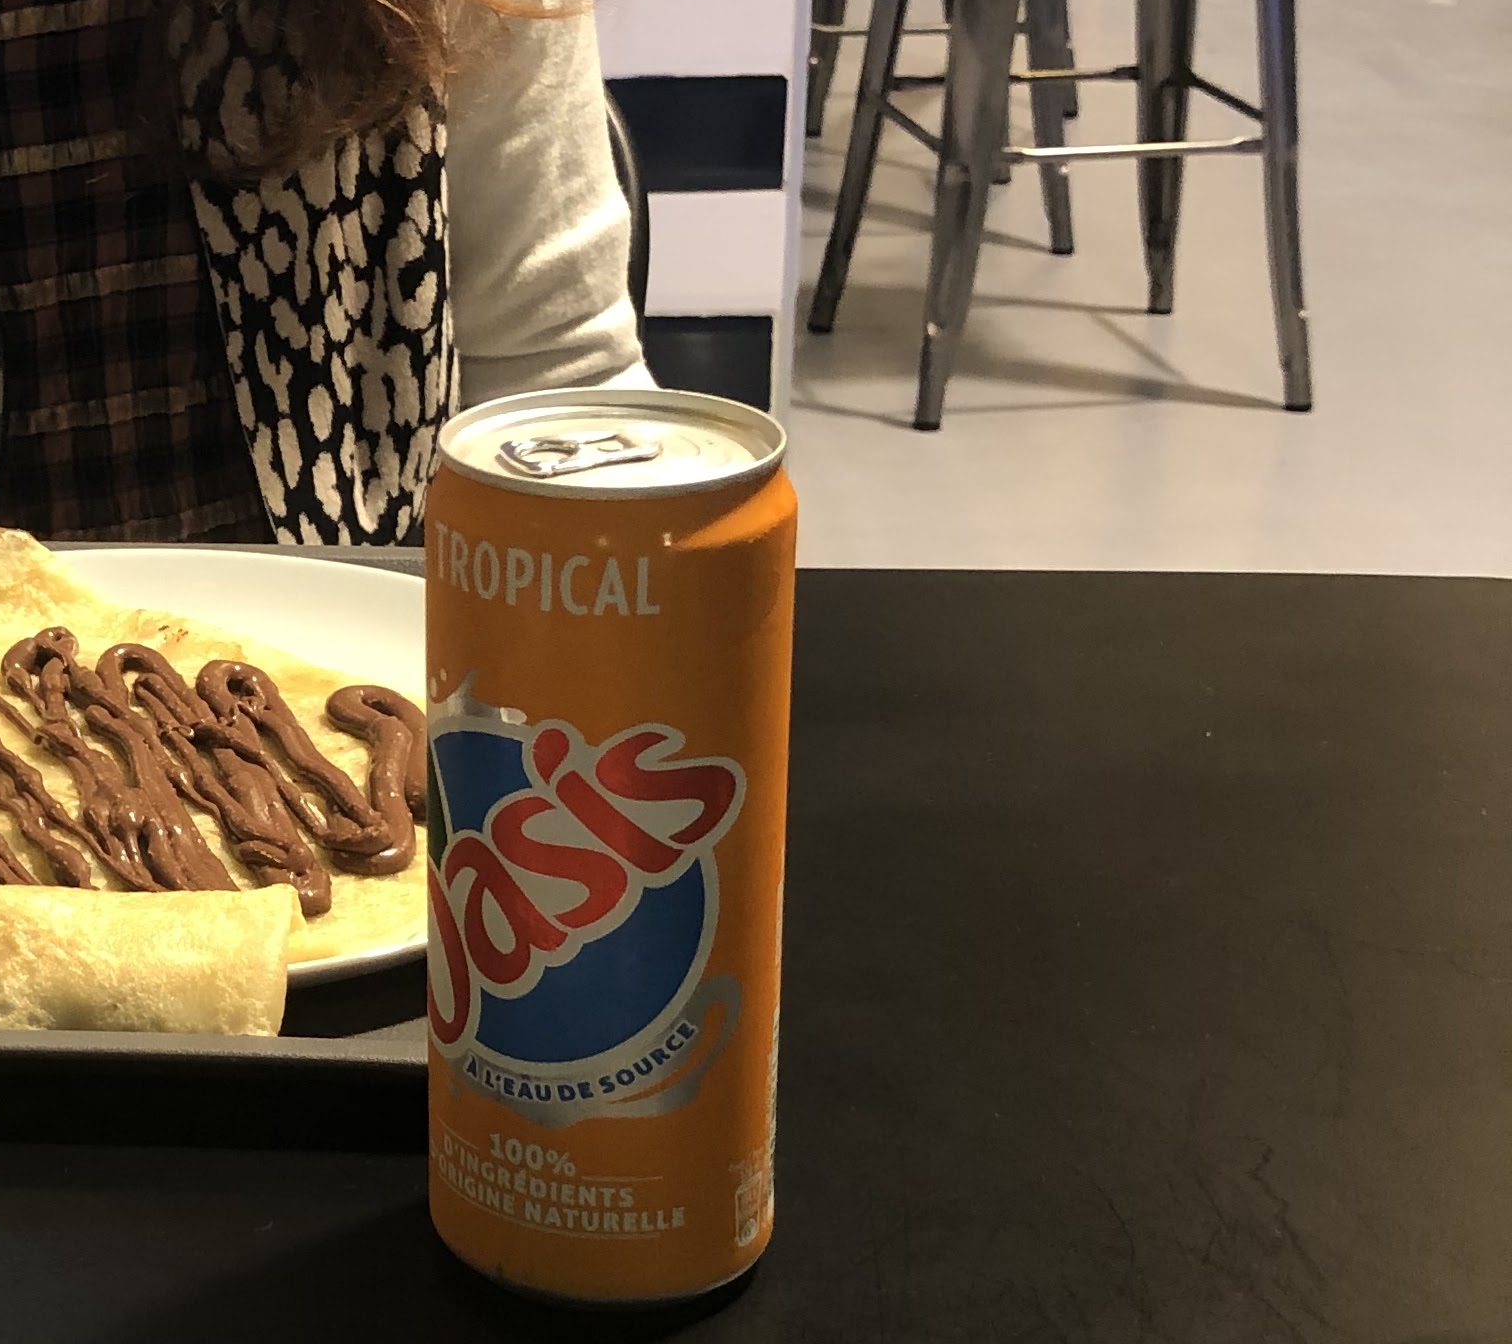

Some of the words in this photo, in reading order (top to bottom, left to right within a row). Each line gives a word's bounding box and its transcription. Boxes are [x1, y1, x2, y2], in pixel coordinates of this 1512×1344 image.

[435, 519, 660, 616] TROPICAL
[484, 1068, 553, 1102] L'EAU
[556, 1081, 595, 1103] DE
[597, 1022, 696, 1095] SOURCE
[443, 1132, 635, 1208] D'INGRÉDIENTS
[489, 1133, 576, 1177] 100%
[524, 1199, 686, 1233] NATURELLE
